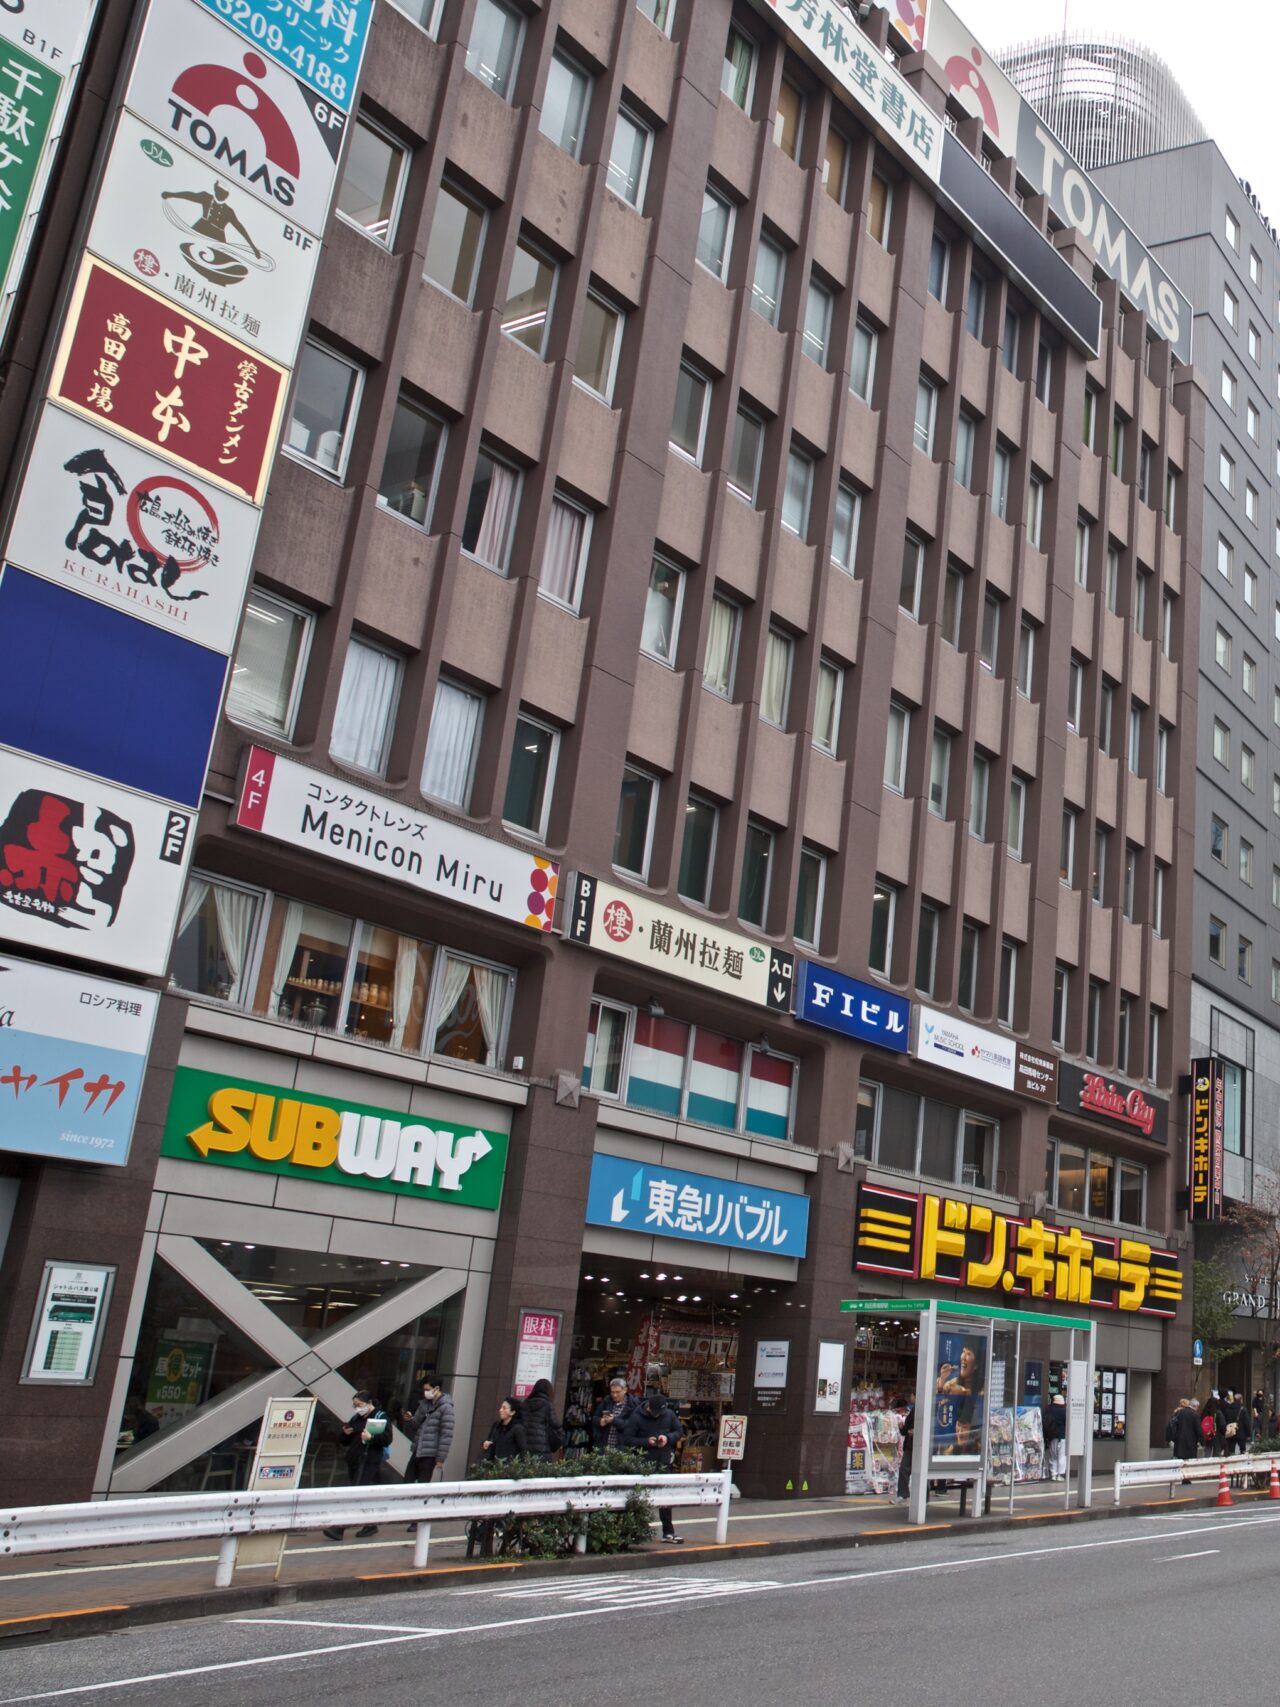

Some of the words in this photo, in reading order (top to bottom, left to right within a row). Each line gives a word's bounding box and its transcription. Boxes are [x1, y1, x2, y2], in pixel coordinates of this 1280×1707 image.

[23, 28, 63, 60] B1F
[314, 102, 345, 130] 6F
[167, 98, 296, 207] TOMAS
[282, 224, 313, 251] B1F
[1034, 124, 1180, 343] TOMAS
[87, 313, 132, 413] 高田馬場
[151, 325, 209, 442] 中本
[218, 360, 259, 464] 蒙古タンメン
[63, 558, 190, 621] KURAHASHI
[247, 768, 266, 810] 4F
[306, 782, 428, 840] コンタクトレンズ
[164, 815, 187, 858] 2F
[300, 803, 423, 876] Menicon
[435, 853, 503, 903] Miru
[576, 879, 591, 937] B1F
[770, 958, 793, 979] 入口
[79, 992, 142, 1017] ロシア料理
[0, 1065, 126, 1115] ャイカ
[59, 1130, 90, 1146] since
[89, 1134, 115, 1148] 1972
[186, 1087, 493, 1190] SUBWAY
[645, 1180, 788, 1246] 東急リバブル
[524, 1316, 554, 1336] 眼科
